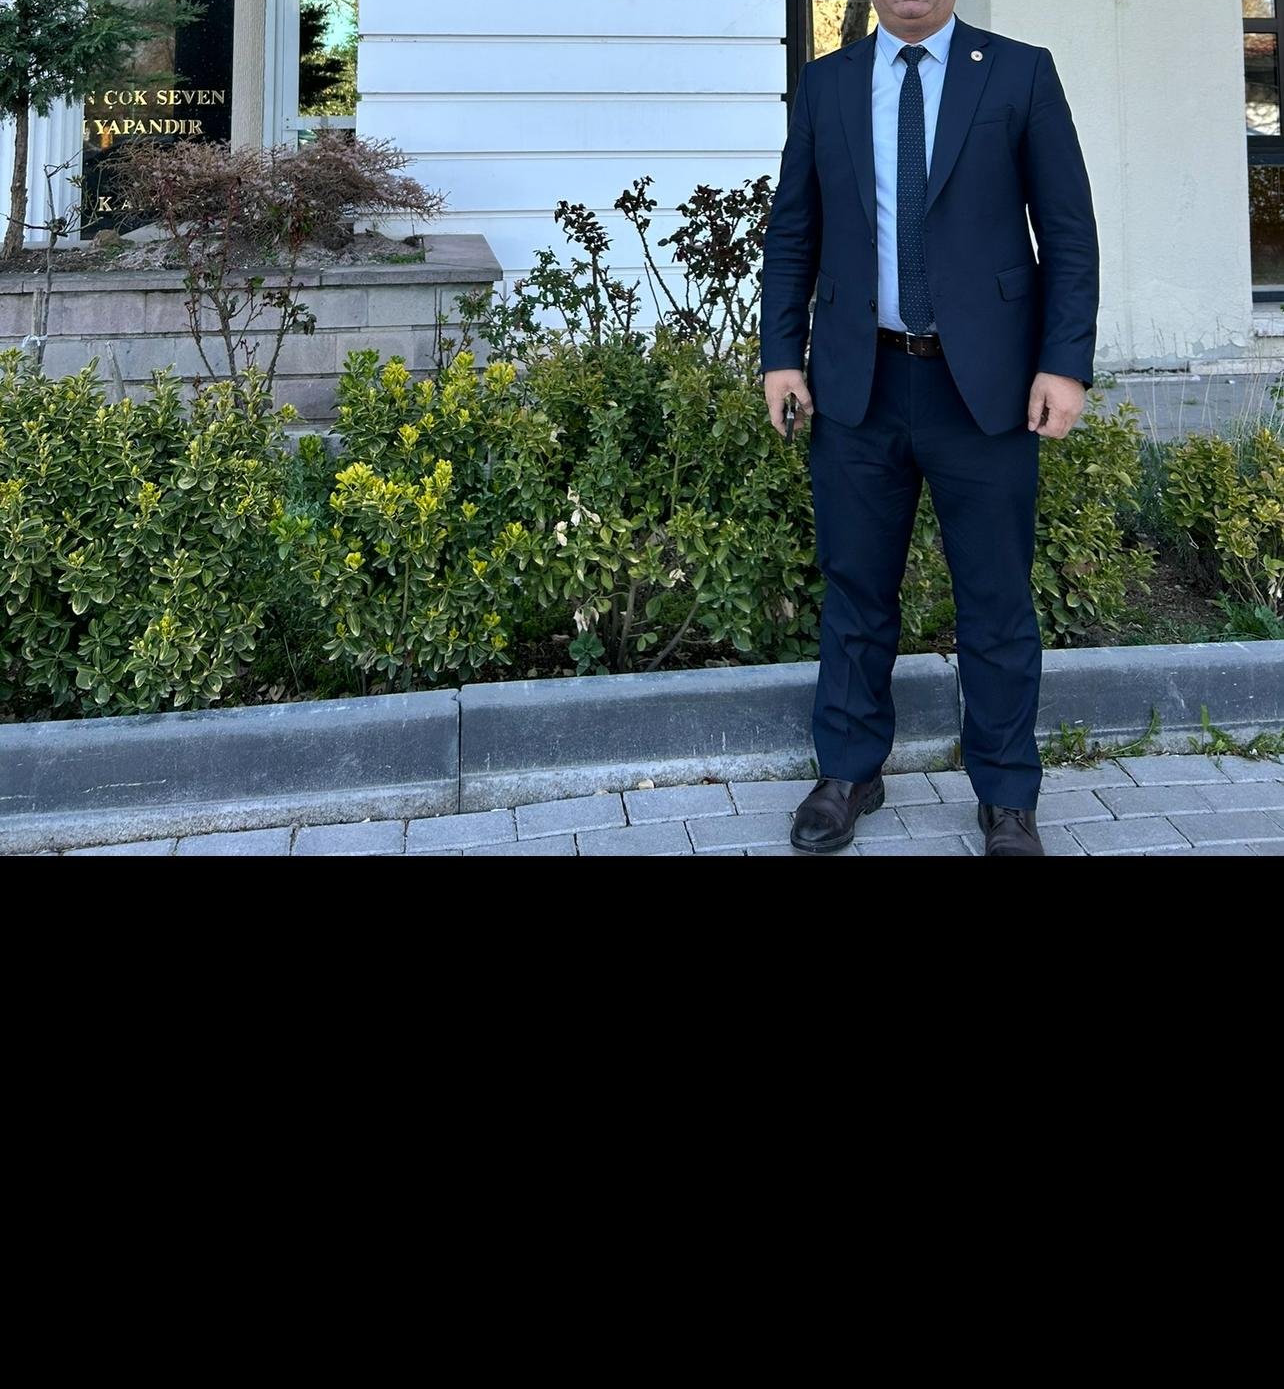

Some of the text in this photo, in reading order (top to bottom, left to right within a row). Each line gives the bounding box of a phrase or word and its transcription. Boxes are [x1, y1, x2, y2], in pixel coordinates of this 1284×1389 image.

[103, 89, 148, 110] ÇOK
[156, 89, 226, 106] SEVEN
[94, 119, 204, 135] YAPANDIR
